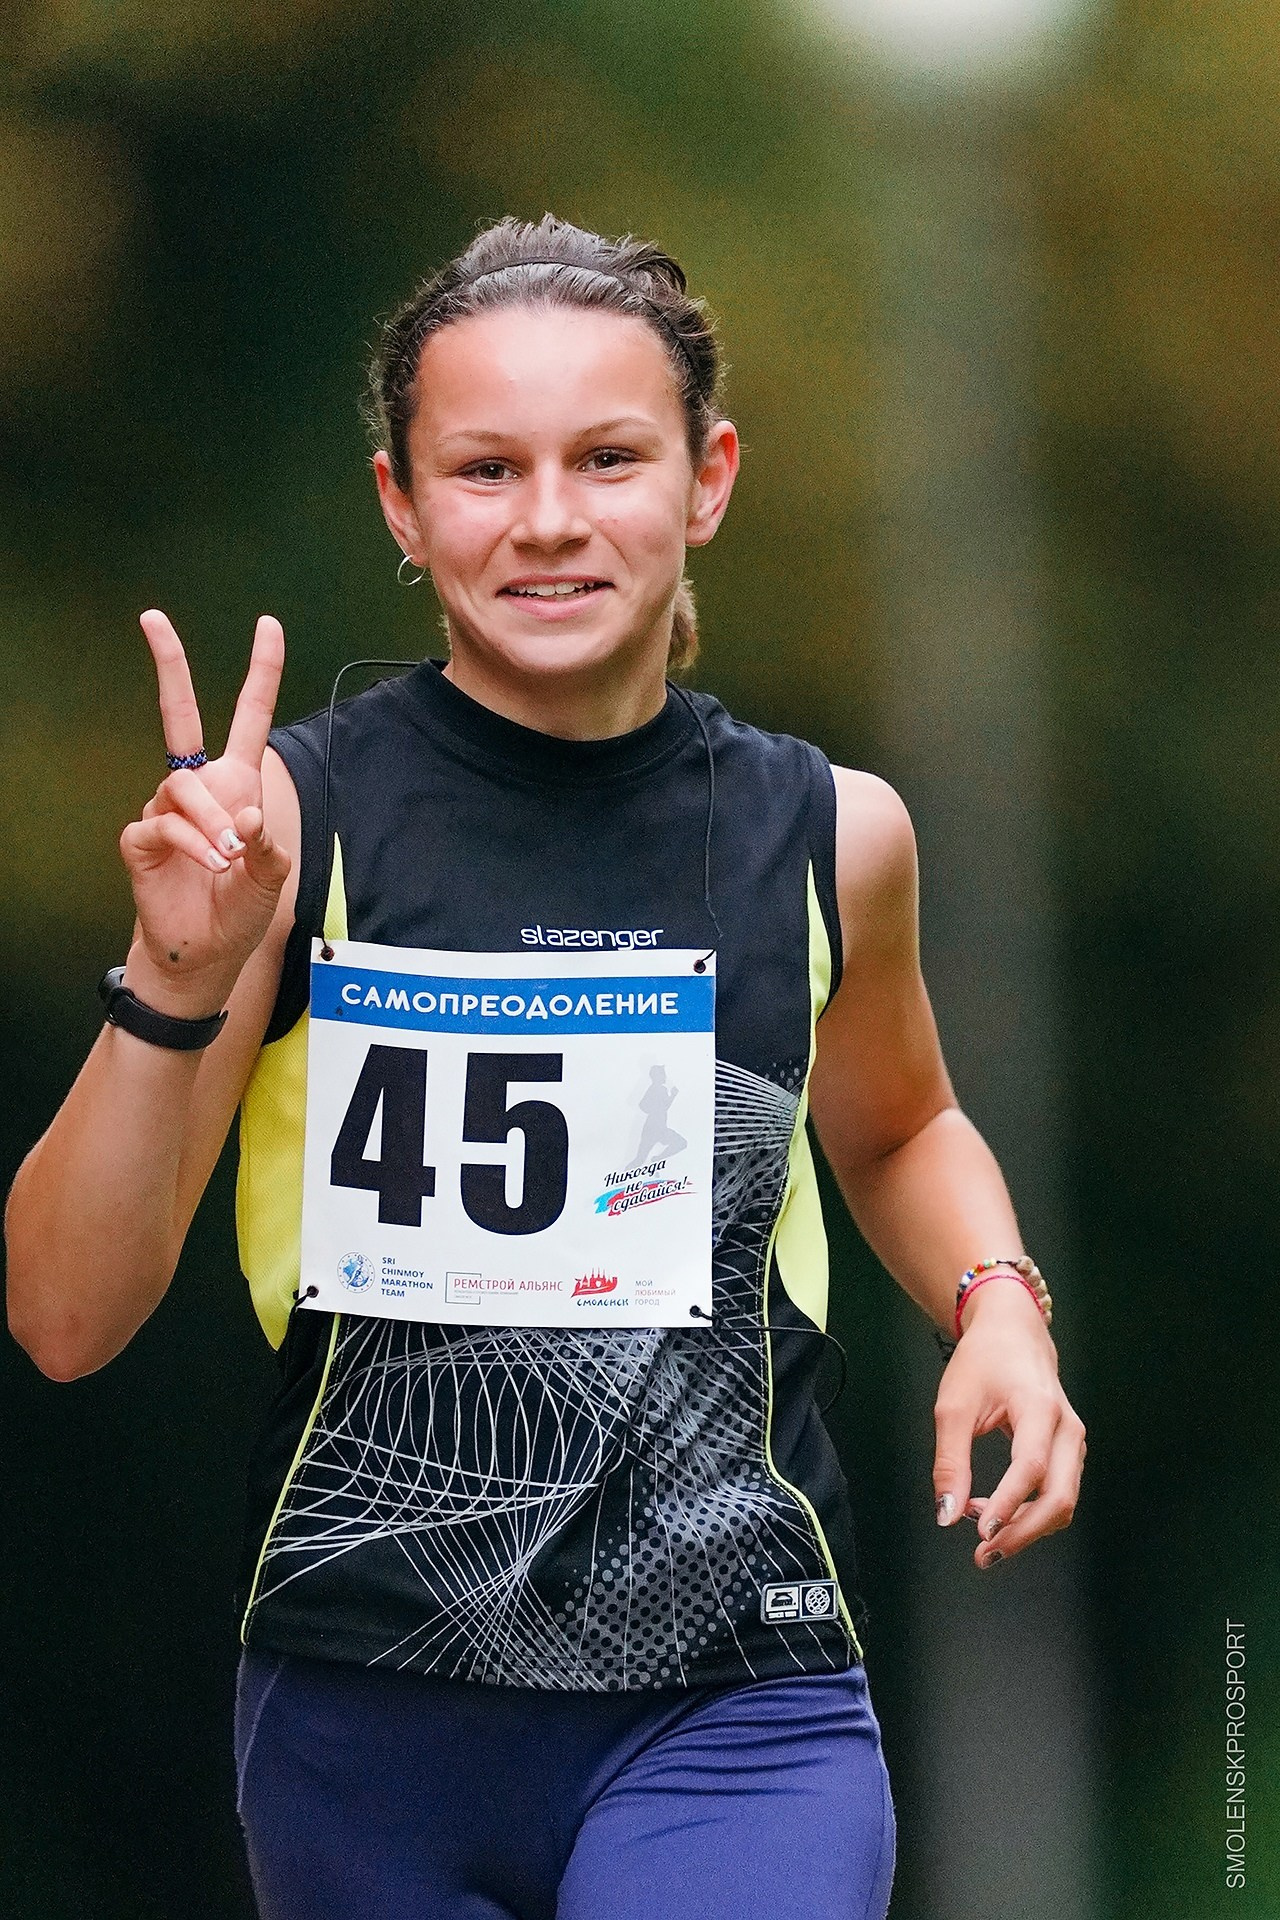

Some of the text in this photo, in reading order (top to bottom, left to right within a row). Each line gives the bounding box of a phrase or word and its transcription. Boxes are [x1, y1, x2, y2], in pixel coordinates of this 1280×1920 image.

[520, 924, 664, 950] slazenger
[340, 983, 679, 1020] САМОПРЕОДОЛЕНИЕ
[330, 1044, 569, 1235] 45
[604, 1160, 666, 1187] Никогда
[613, 1176, 688, 1212] сдавайся!
[625, 1181, 642, 1194] не
[381, 1257, 396, 1265] SRI
[381, 1267, 425, 1278] CHINMOY
[381, 1278, 433, 1289] MARATHON
[454, 1278, 563, 1291] РЕМСТРОЙ АЛЬЯНС
[381, 1288, 405, 1297] TEAM
[635, 1288, 676, 1296] ЛЮБИМЫЙ
[635, 1298, 660, 1306] ГОРОД
